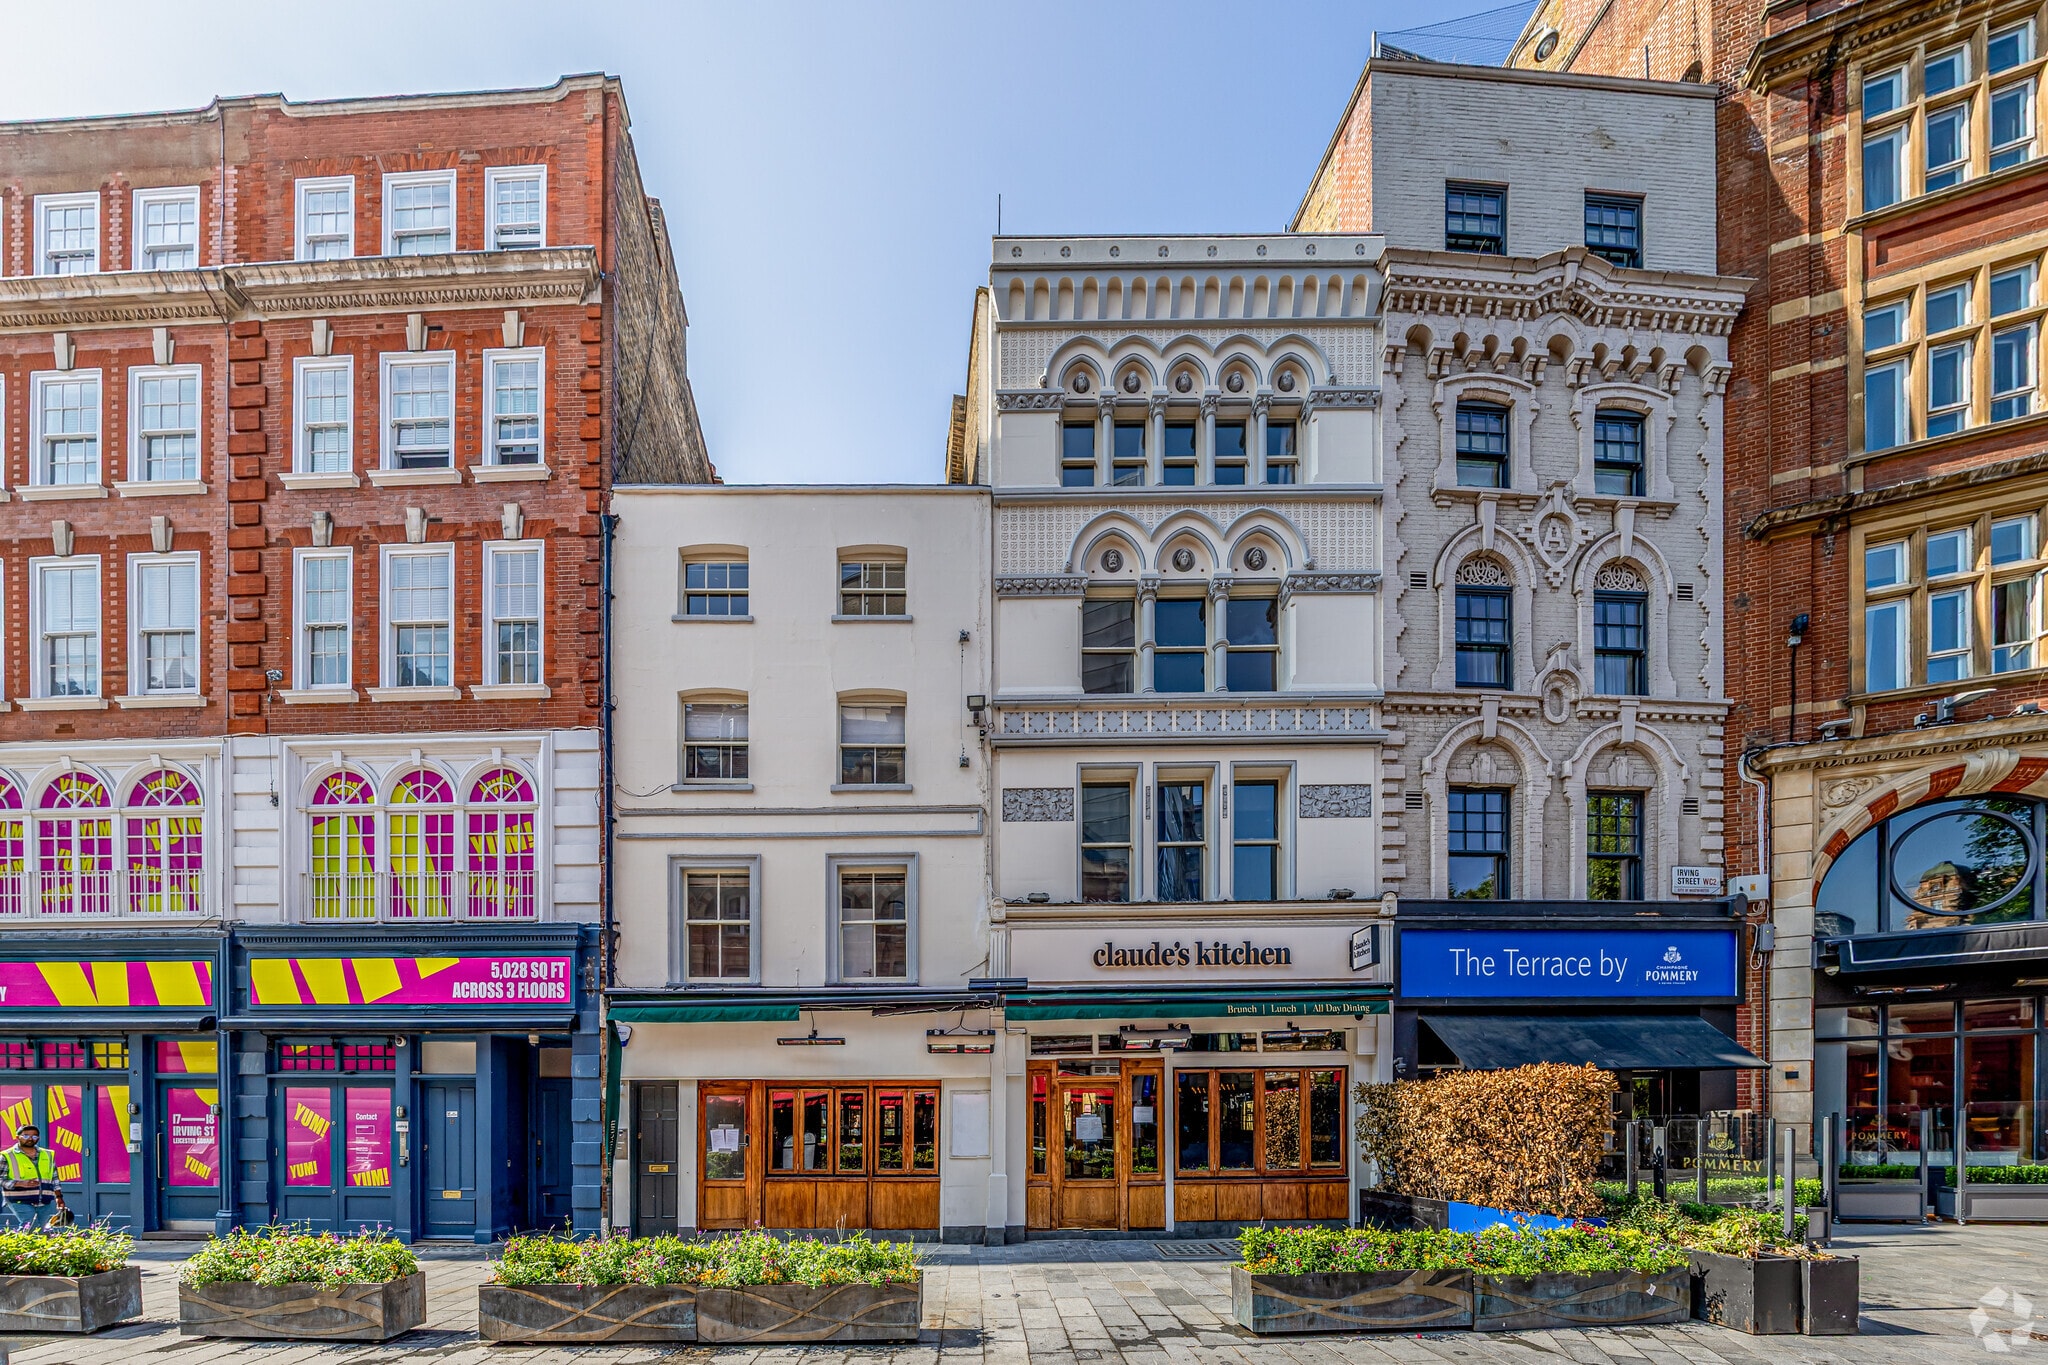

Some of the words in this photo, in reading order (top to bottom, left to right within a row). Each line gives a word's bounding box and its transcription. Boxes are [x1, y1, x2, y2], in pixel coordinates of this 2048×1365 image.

[147, 772, 182, 794] YUM!
[469, 821, 534, 862] YUM!
[1703, 878, 1717, 886] WC2
[1195, 941, 1292, 965] kitchen
[491, 962, 528, 980] 5,028
[530, 962, 548, 980] SQ
[550, 962, 566, 978] FT
[1449, 948, 1495, 976] The
[1503, 948, 1591, 976] Terrace
[1600, 949, 1628, 983] by
[1645, 970, 1698, 981] POMMERY
[452, 982, 504, 999] ACROSS
[506, 982, 515, 999] 3
[517, 982, 565, 999] FLOORS
[1227, 1005, 1257, 1014] Brunch
[1271, 1004, 1297, 1013] Lunch
[1312, 1004, 1324, 1013] All
[1325, 1004, 1341, 1014] Day
[1342, 1003, 1370, 1013] Dining
[294, 1102, 330, 1138] YUM!
[355, 1113, 378, 1121] Contact
[172, 1125, 202, 1137] IRVING
[203, 1125, 216, 1137] ST
[1851, 1131, 1908, 1141] POMMERY
[57, 1162, 81, 1182] UM!
[184, 1154, 212, 1181] YUM!
[289, 1160, 319, 1179] YUM!
[1682, 1156, 1763, 1173] POMMERY
[352, 1167, 391, 1187] YUM!
